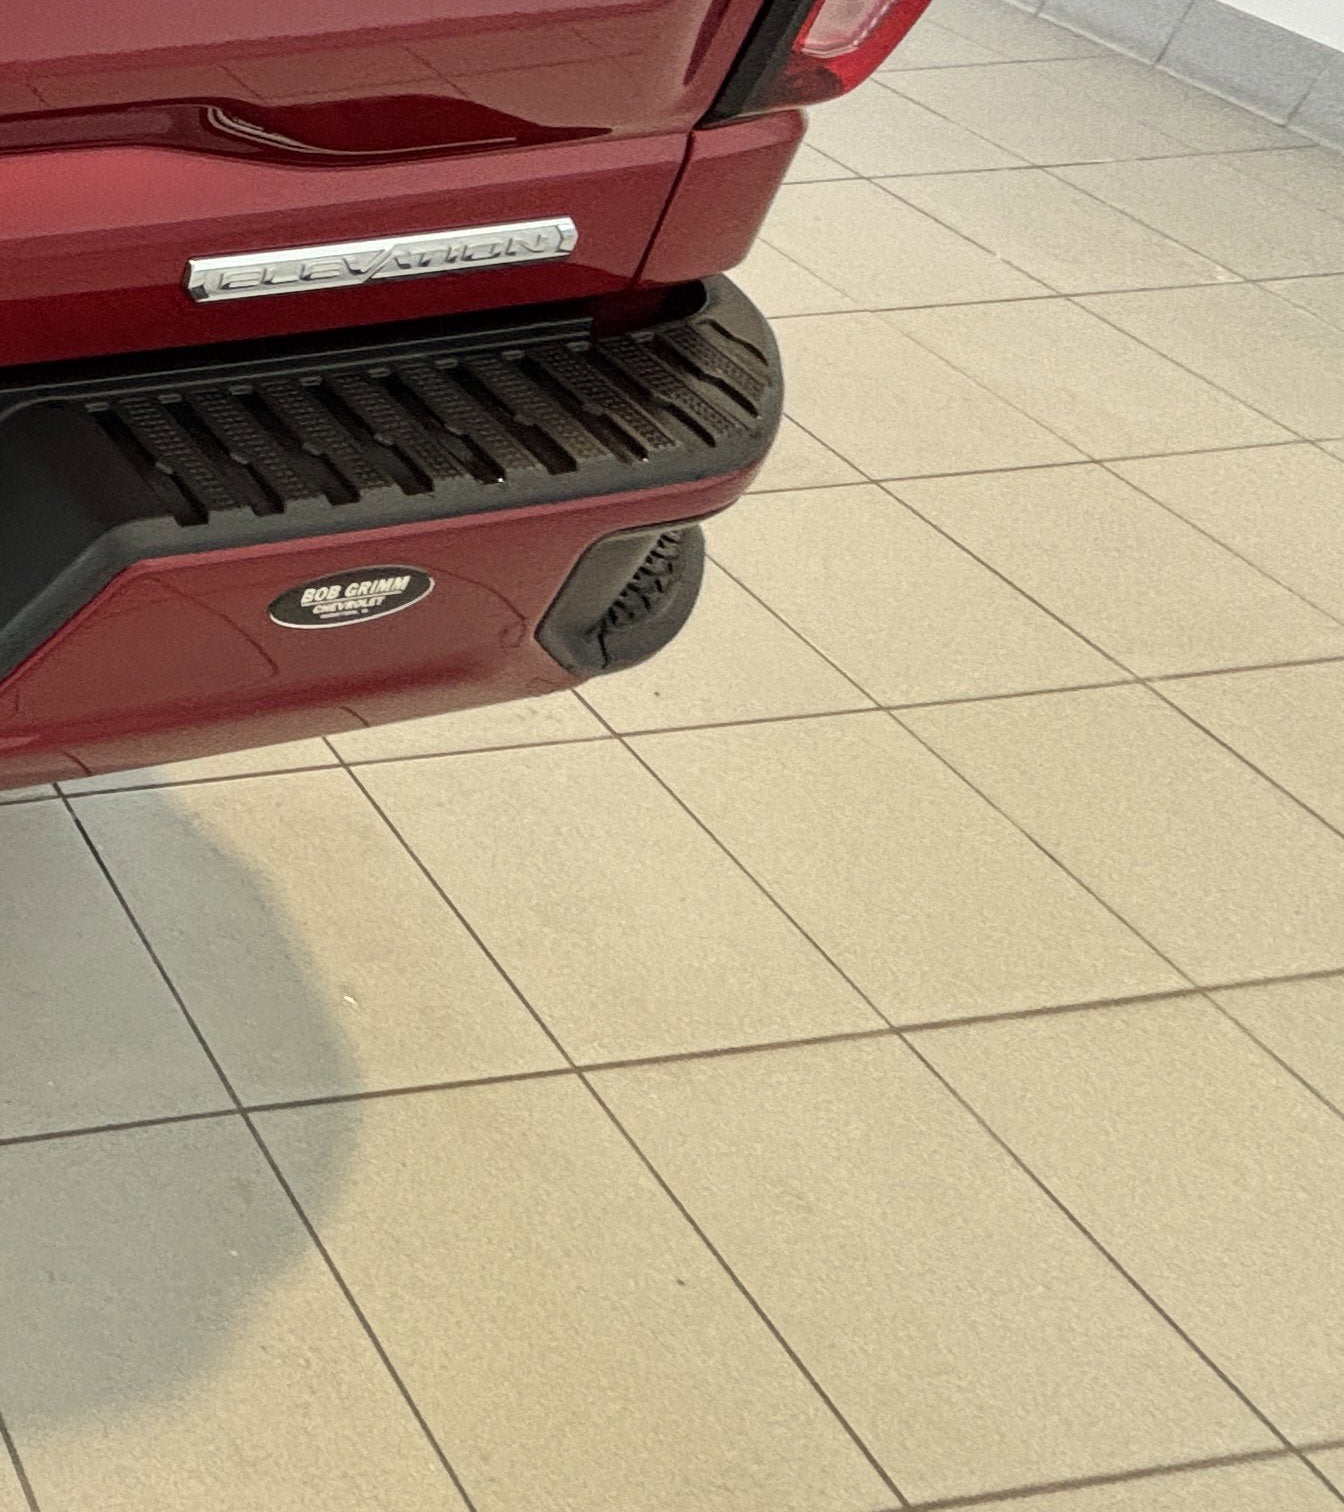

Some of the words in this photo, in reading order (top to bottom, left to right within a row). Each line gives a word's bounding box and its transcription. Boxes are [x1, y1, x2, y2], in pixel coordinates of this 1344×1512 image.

[212, 226, 552, 292] ELEVATION
[301, 585, 342, 605] BOB
[344, 575, 411, 598] GRIMM
[312, 596, 386, 614] CHEVROLET
